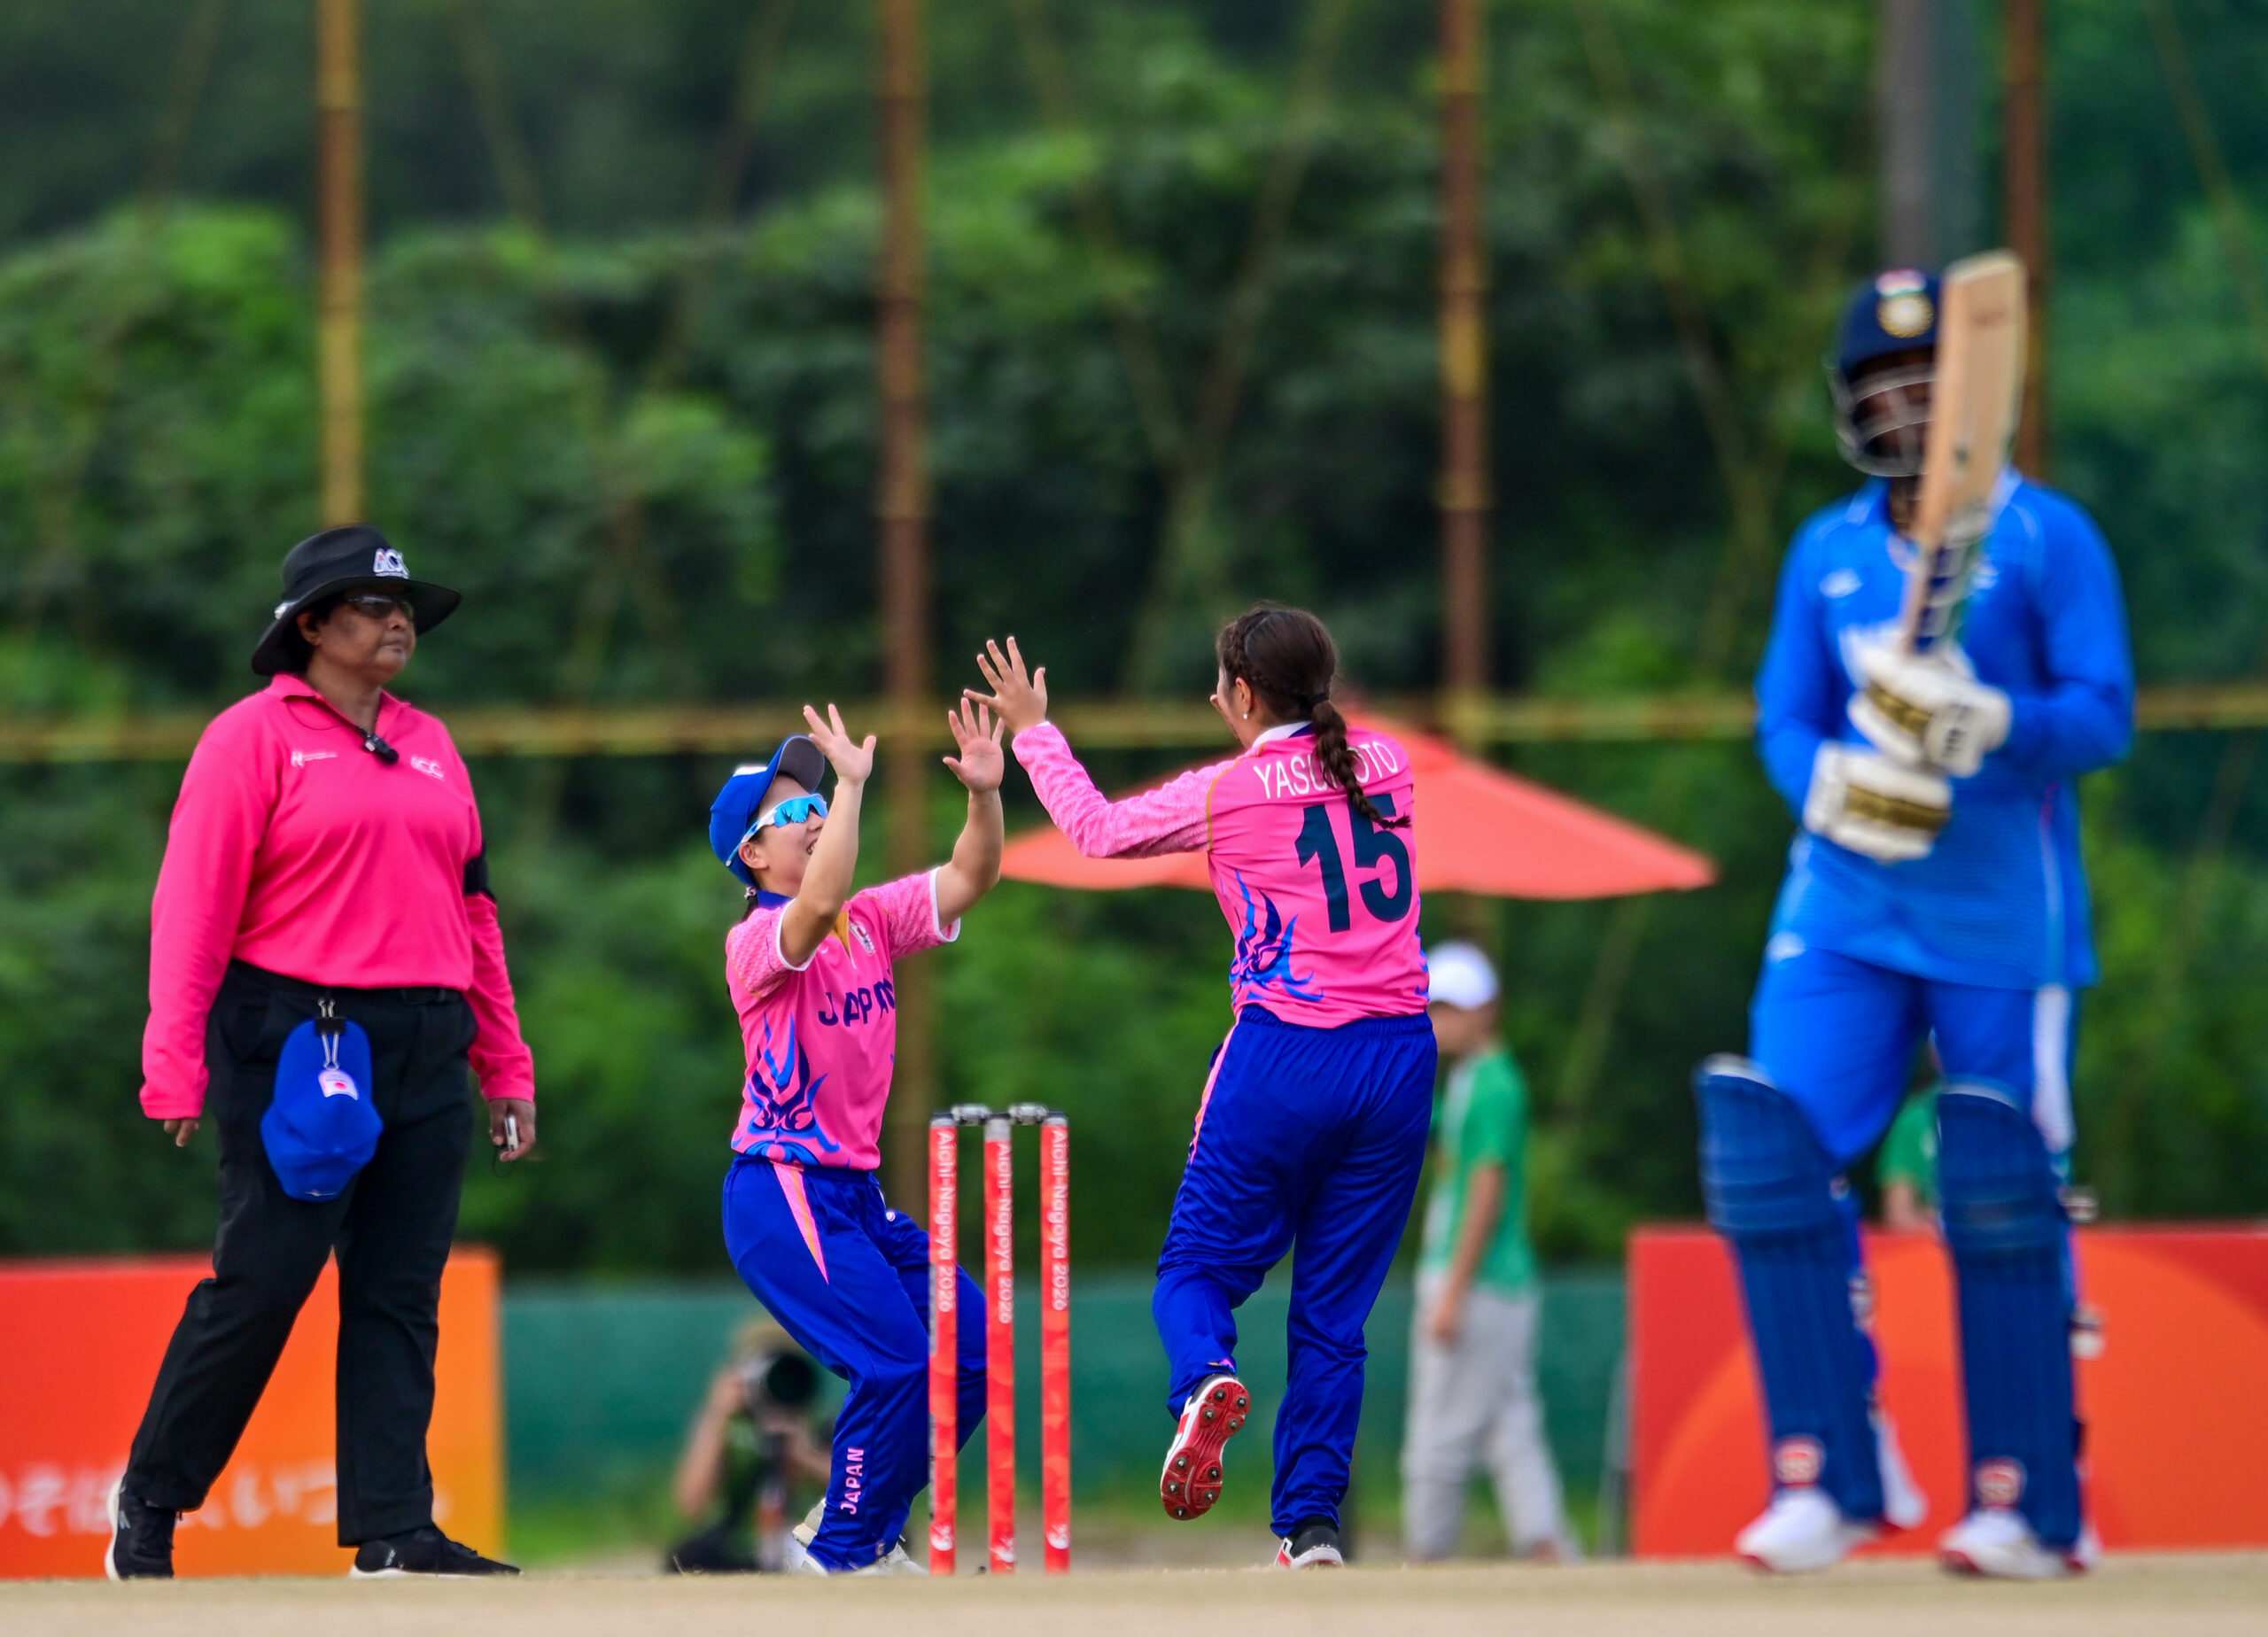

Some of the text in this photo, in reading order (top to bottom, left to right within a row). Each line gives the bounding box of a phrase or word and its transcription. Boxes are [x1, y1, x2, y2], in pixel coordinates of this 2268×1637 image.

[1253, 741, 1399, 799] YASUOTO
[1294, 794, 1412, 933] 15
[934, 1131, 956, 1313] Aichi-Nagoya 2026
[993, 1143, 1013, 1323] Aichi-Nagoya 2026
[1046, 1130, 1069, 1311] Aichi-Nagoya 2026
[840, 1447, 865, 1515] JAPAN
